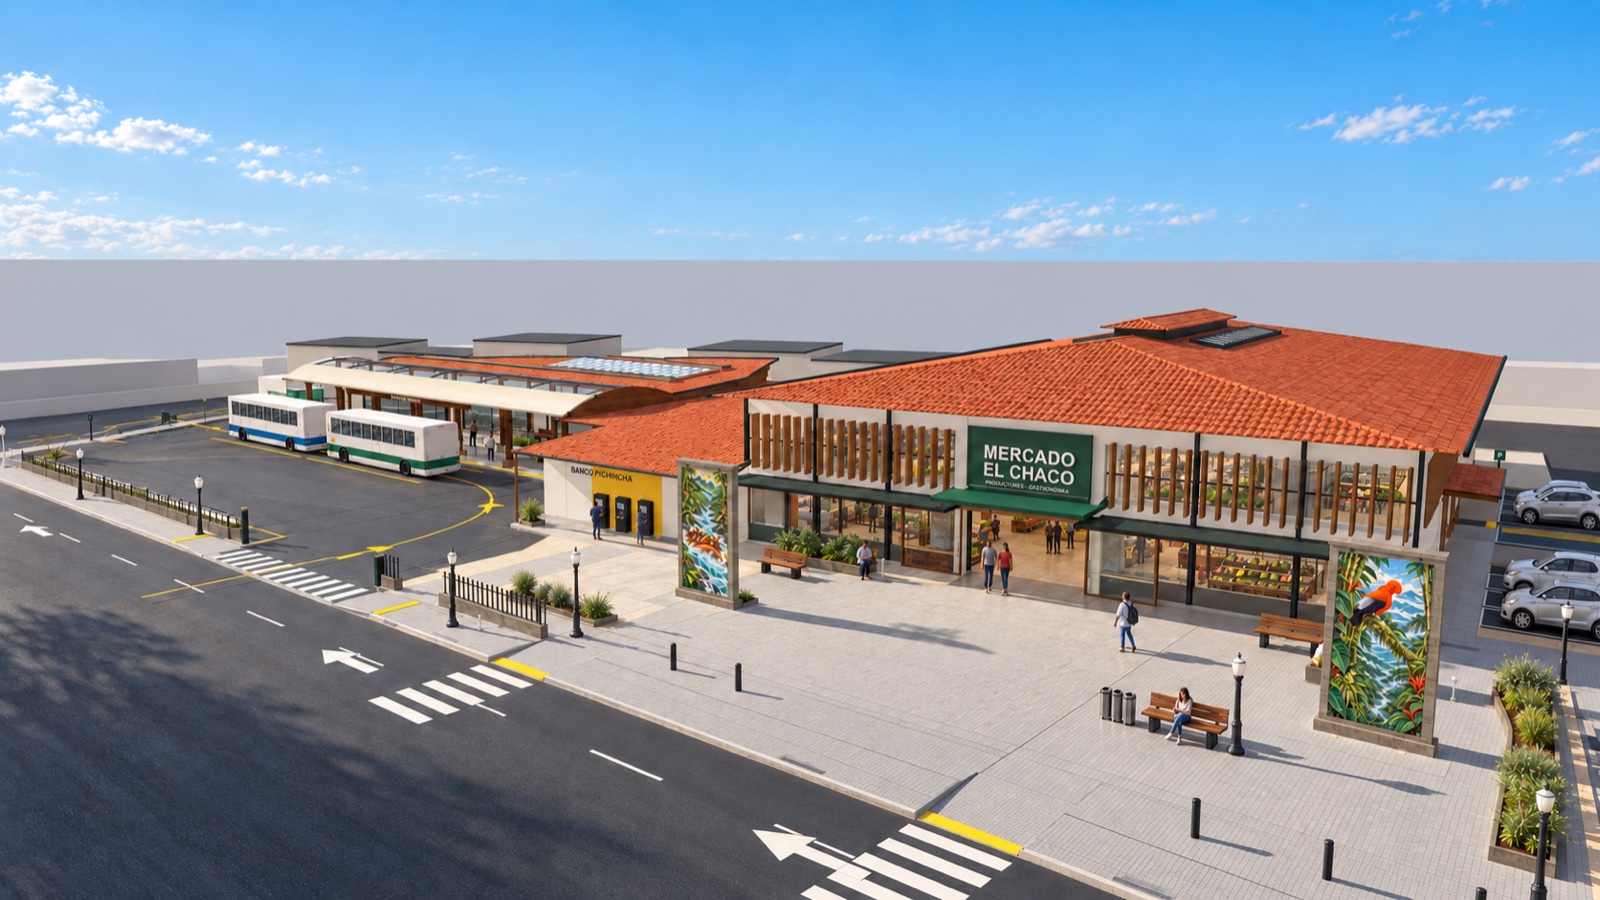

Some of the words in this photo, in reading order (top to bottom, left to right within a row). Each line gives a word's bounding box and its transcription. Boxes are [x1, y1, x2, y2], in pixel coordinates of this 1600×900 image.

[984, 444, 1075, 467] MERCADO
[571, 466, 593, 476] BANCO
[595, 469, 633, 482] PICHINCHA
[983, 462, 1004, 478] EL
[1010, 464, 1075, 486] CHACO
